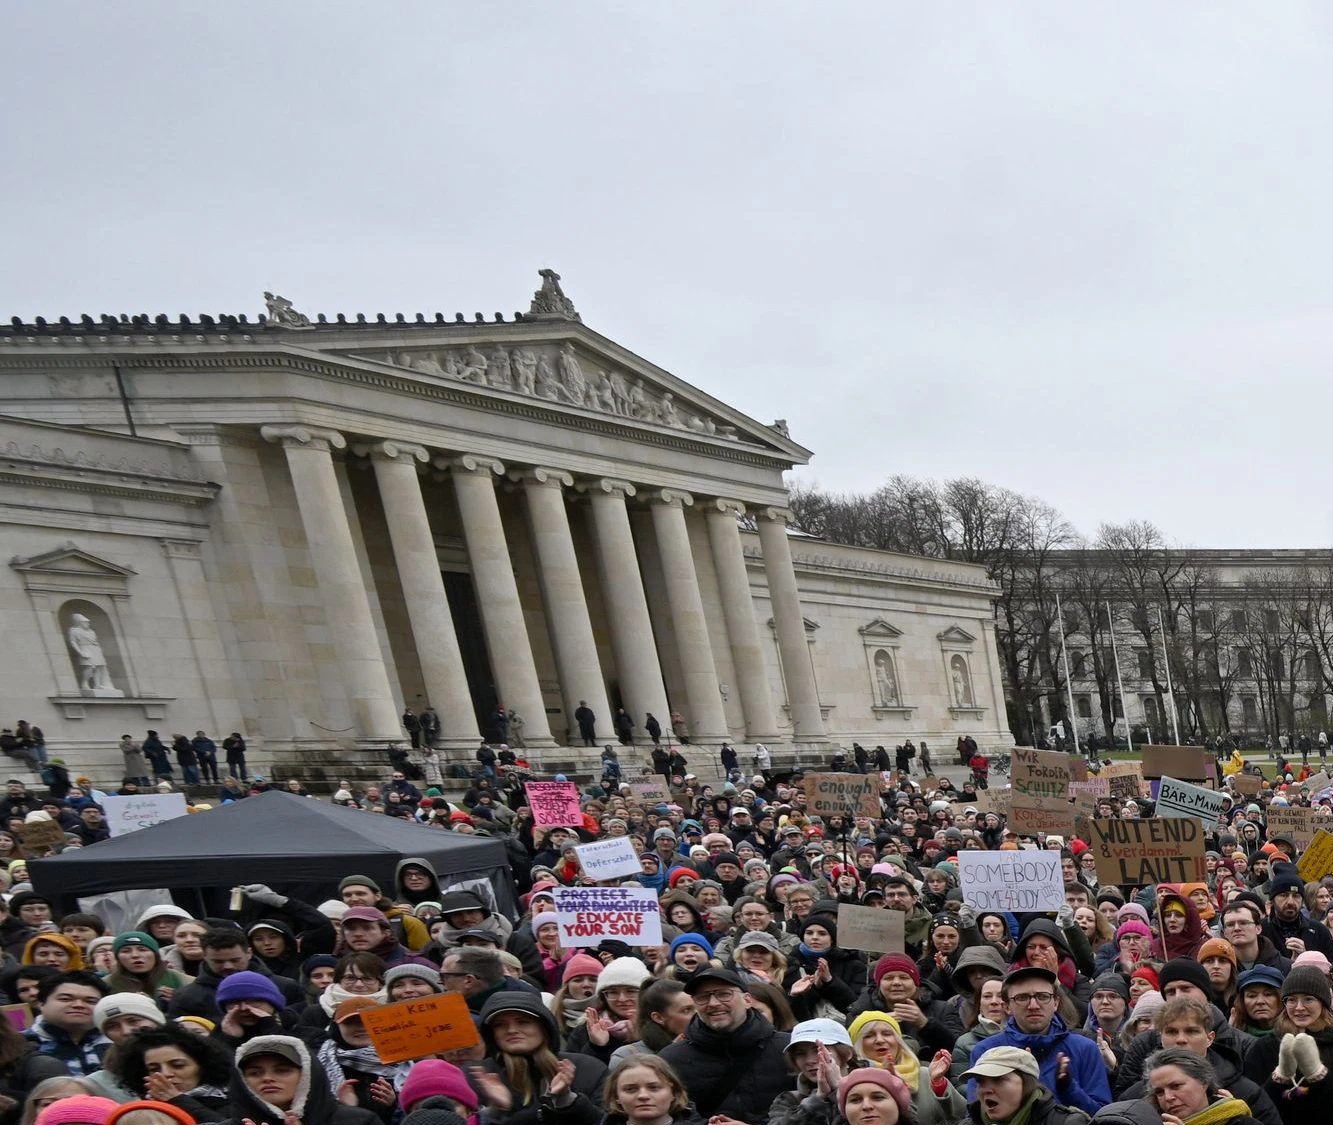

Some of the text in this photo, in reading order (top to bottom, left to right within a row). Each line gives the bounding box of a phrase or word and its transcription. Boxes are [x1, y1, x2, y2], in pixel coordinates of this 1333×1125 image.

[819, 777, 873, 801] enough
[1015, 778, 1067, 799] SCHUTZ
[815, 800, 864, 814] enough
[1116, 843, 1184, 858] verdammt
[586, 853, 634, 869] Opferschutz
[576, 913, 644, 924] EDUCATE
[563, 923, 641, 936] YOUR SON
[406, 1002, 438, 1014] KEIN
